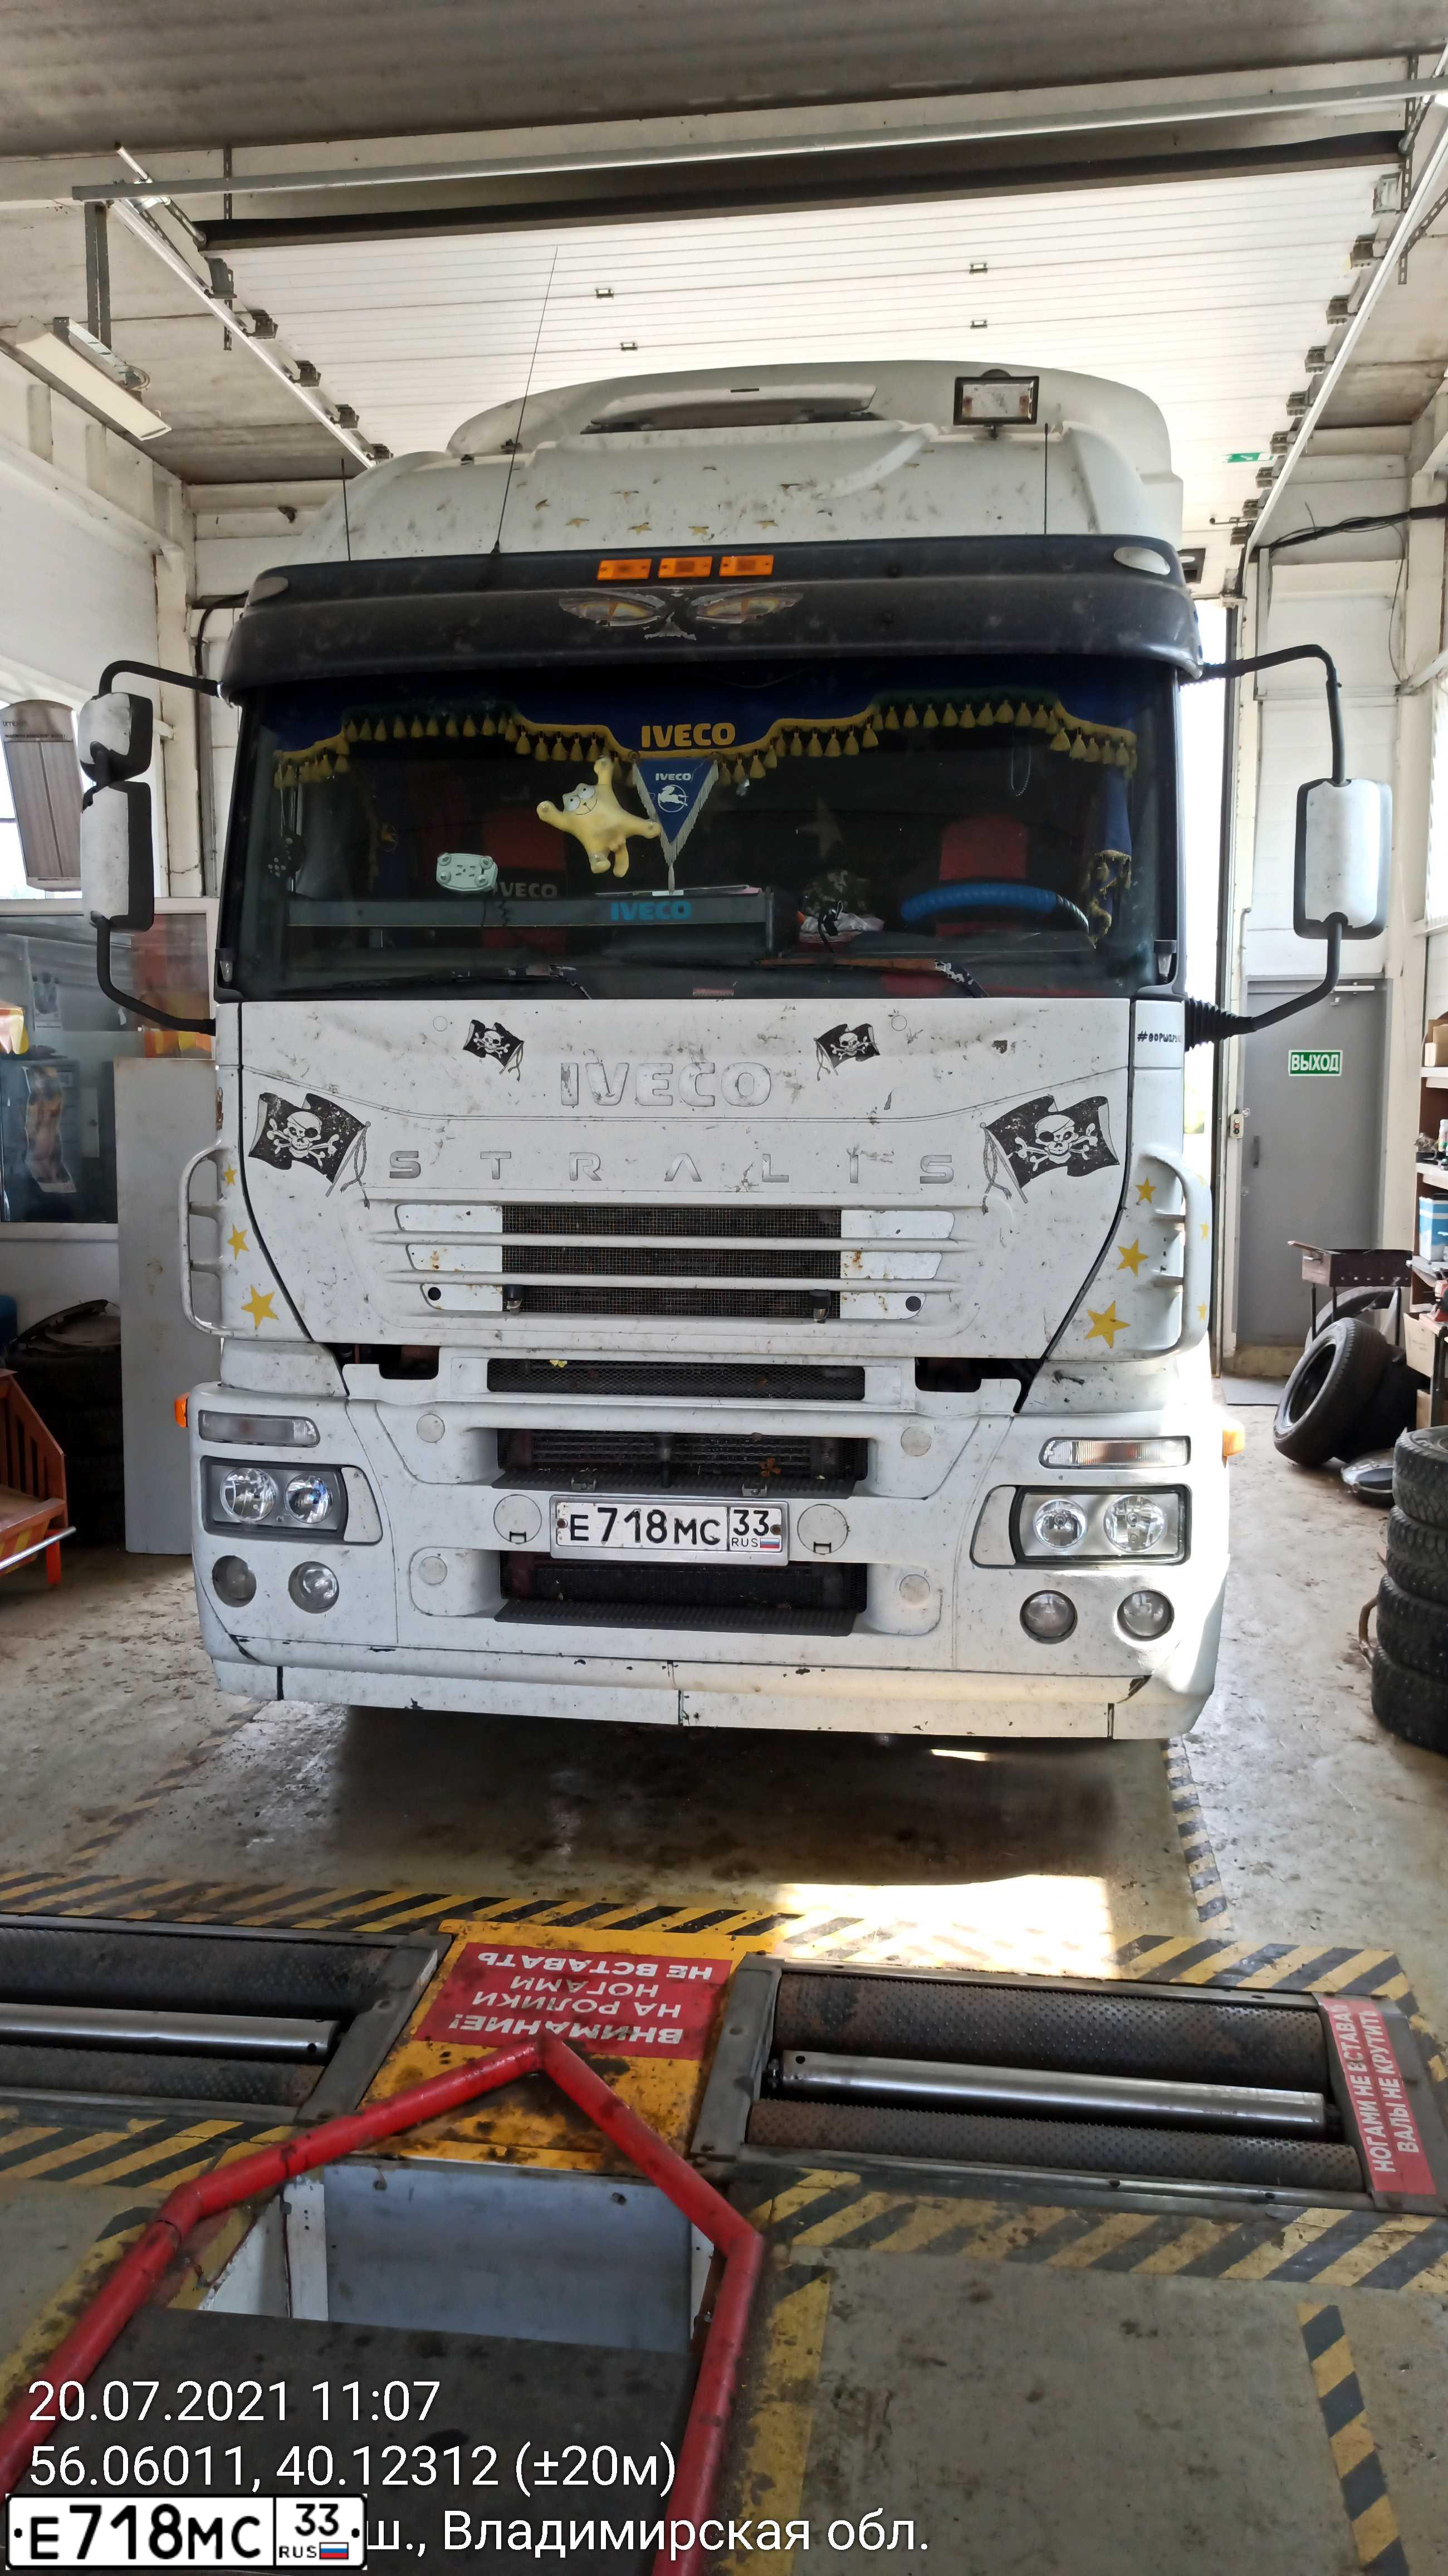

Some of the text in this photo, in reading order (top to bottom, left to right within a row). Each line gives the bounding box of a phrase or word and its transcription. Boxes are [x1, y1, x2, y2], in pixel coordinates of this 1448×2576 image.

[641, 723, 735, 747] IVECO
[655, 773, 691, 781] IVECO
[612, 901, 692, 920] IVECO
[1292, 1054, 1339, 1072] ВЫХОД
[560, 1062, 772, 1108] IVECO
[388, 1150, 955, 1184] STRALIS
[731, 1537, 759, 1548] RUS
[477, 1951, 713, 1980] НЕ ВСТАВАТЬ
[510, 1975, 659, 1998] НОГАМИ
[472, 1991, 681, 2018] НА РОЛИКИ
[448, 2013, 683, 2045] ВНИМАНИЕ!
[1350, 2075, 1374, 2097] НЕ
[1358, 2010, 1420, 2154] ВАЛЫ НЕ КРУТИТЬ
[1354, 2100, 1396, 2173] НОГАМИ
